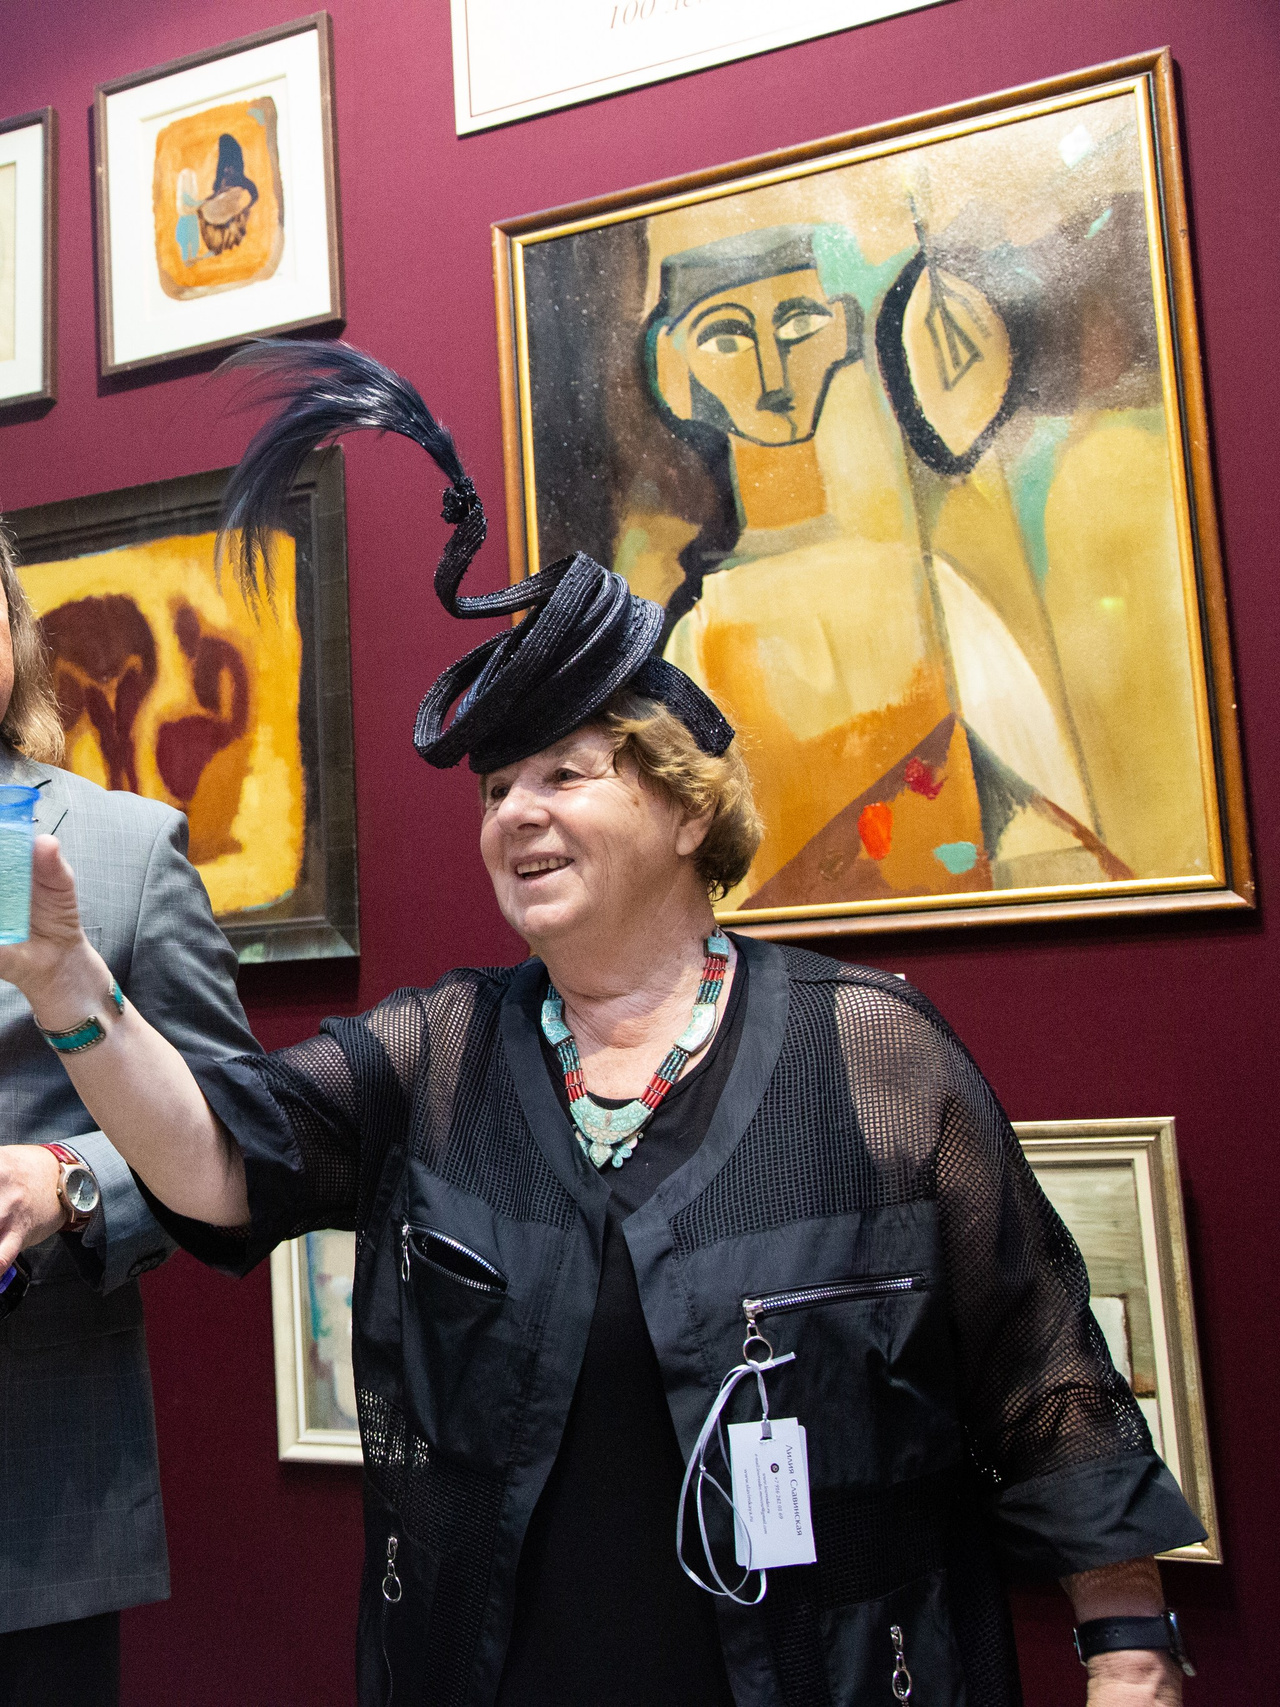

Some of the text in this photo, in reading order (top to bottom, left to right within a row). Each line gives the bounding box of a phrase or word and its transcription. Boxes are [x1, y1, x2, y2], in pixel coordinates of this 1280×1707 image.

[610, 0, 656, 29] 100
[785, 1444, 802, 1536] Лилия Славинская
